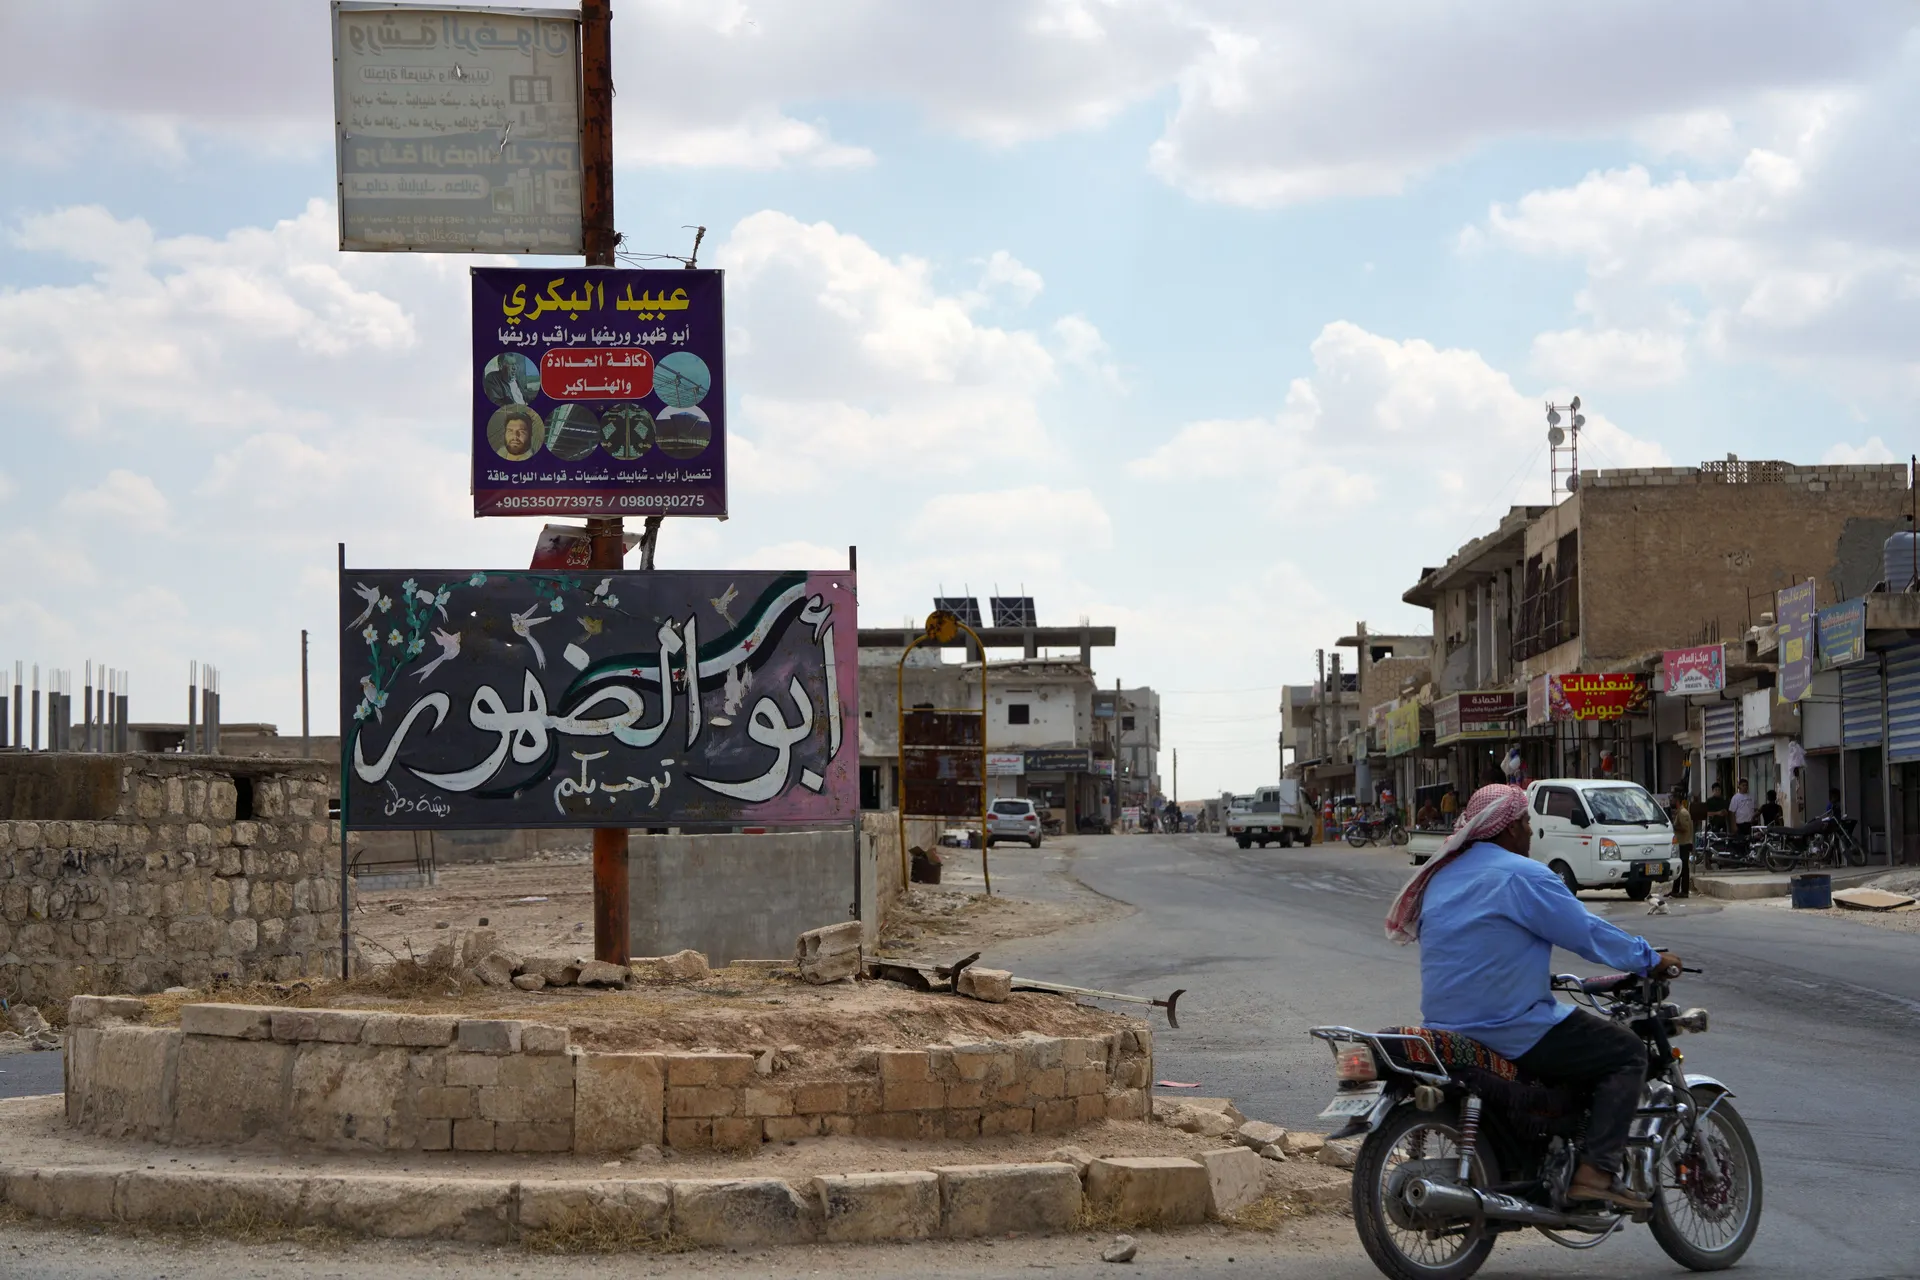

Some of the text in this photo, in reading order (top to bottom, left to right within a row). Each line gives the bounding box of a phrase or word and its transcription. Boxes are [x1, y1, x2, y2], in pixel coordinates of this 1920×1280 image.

[502, 277, 690, 325] عبيد البكري
[498, 324, 690, 346] أبو ظهور وريفها سراقب وريفها
[547, 352, 647, 368] لكافة الحدادة
[562, 377, 632, 395] والهناكير
[487, 469, 509, 482] طاقة
[540, 470, 567, 483] قواعد
[575, 468, 609, 483] شمسيات
[617, 468, 648, 483] شبابيك
[655, 470, 679, 483] أبواب
[682, 468, 712, 483] تفصيل
[495, 496, 603, 508] +905350773975
[620, 495, 705, 507] 0980930275
[354, 592, 843, 803] أبو الضهور
[1574, 698, 1625, 721] حبوش
[552, 750, 674, 816] ترحب بكم
